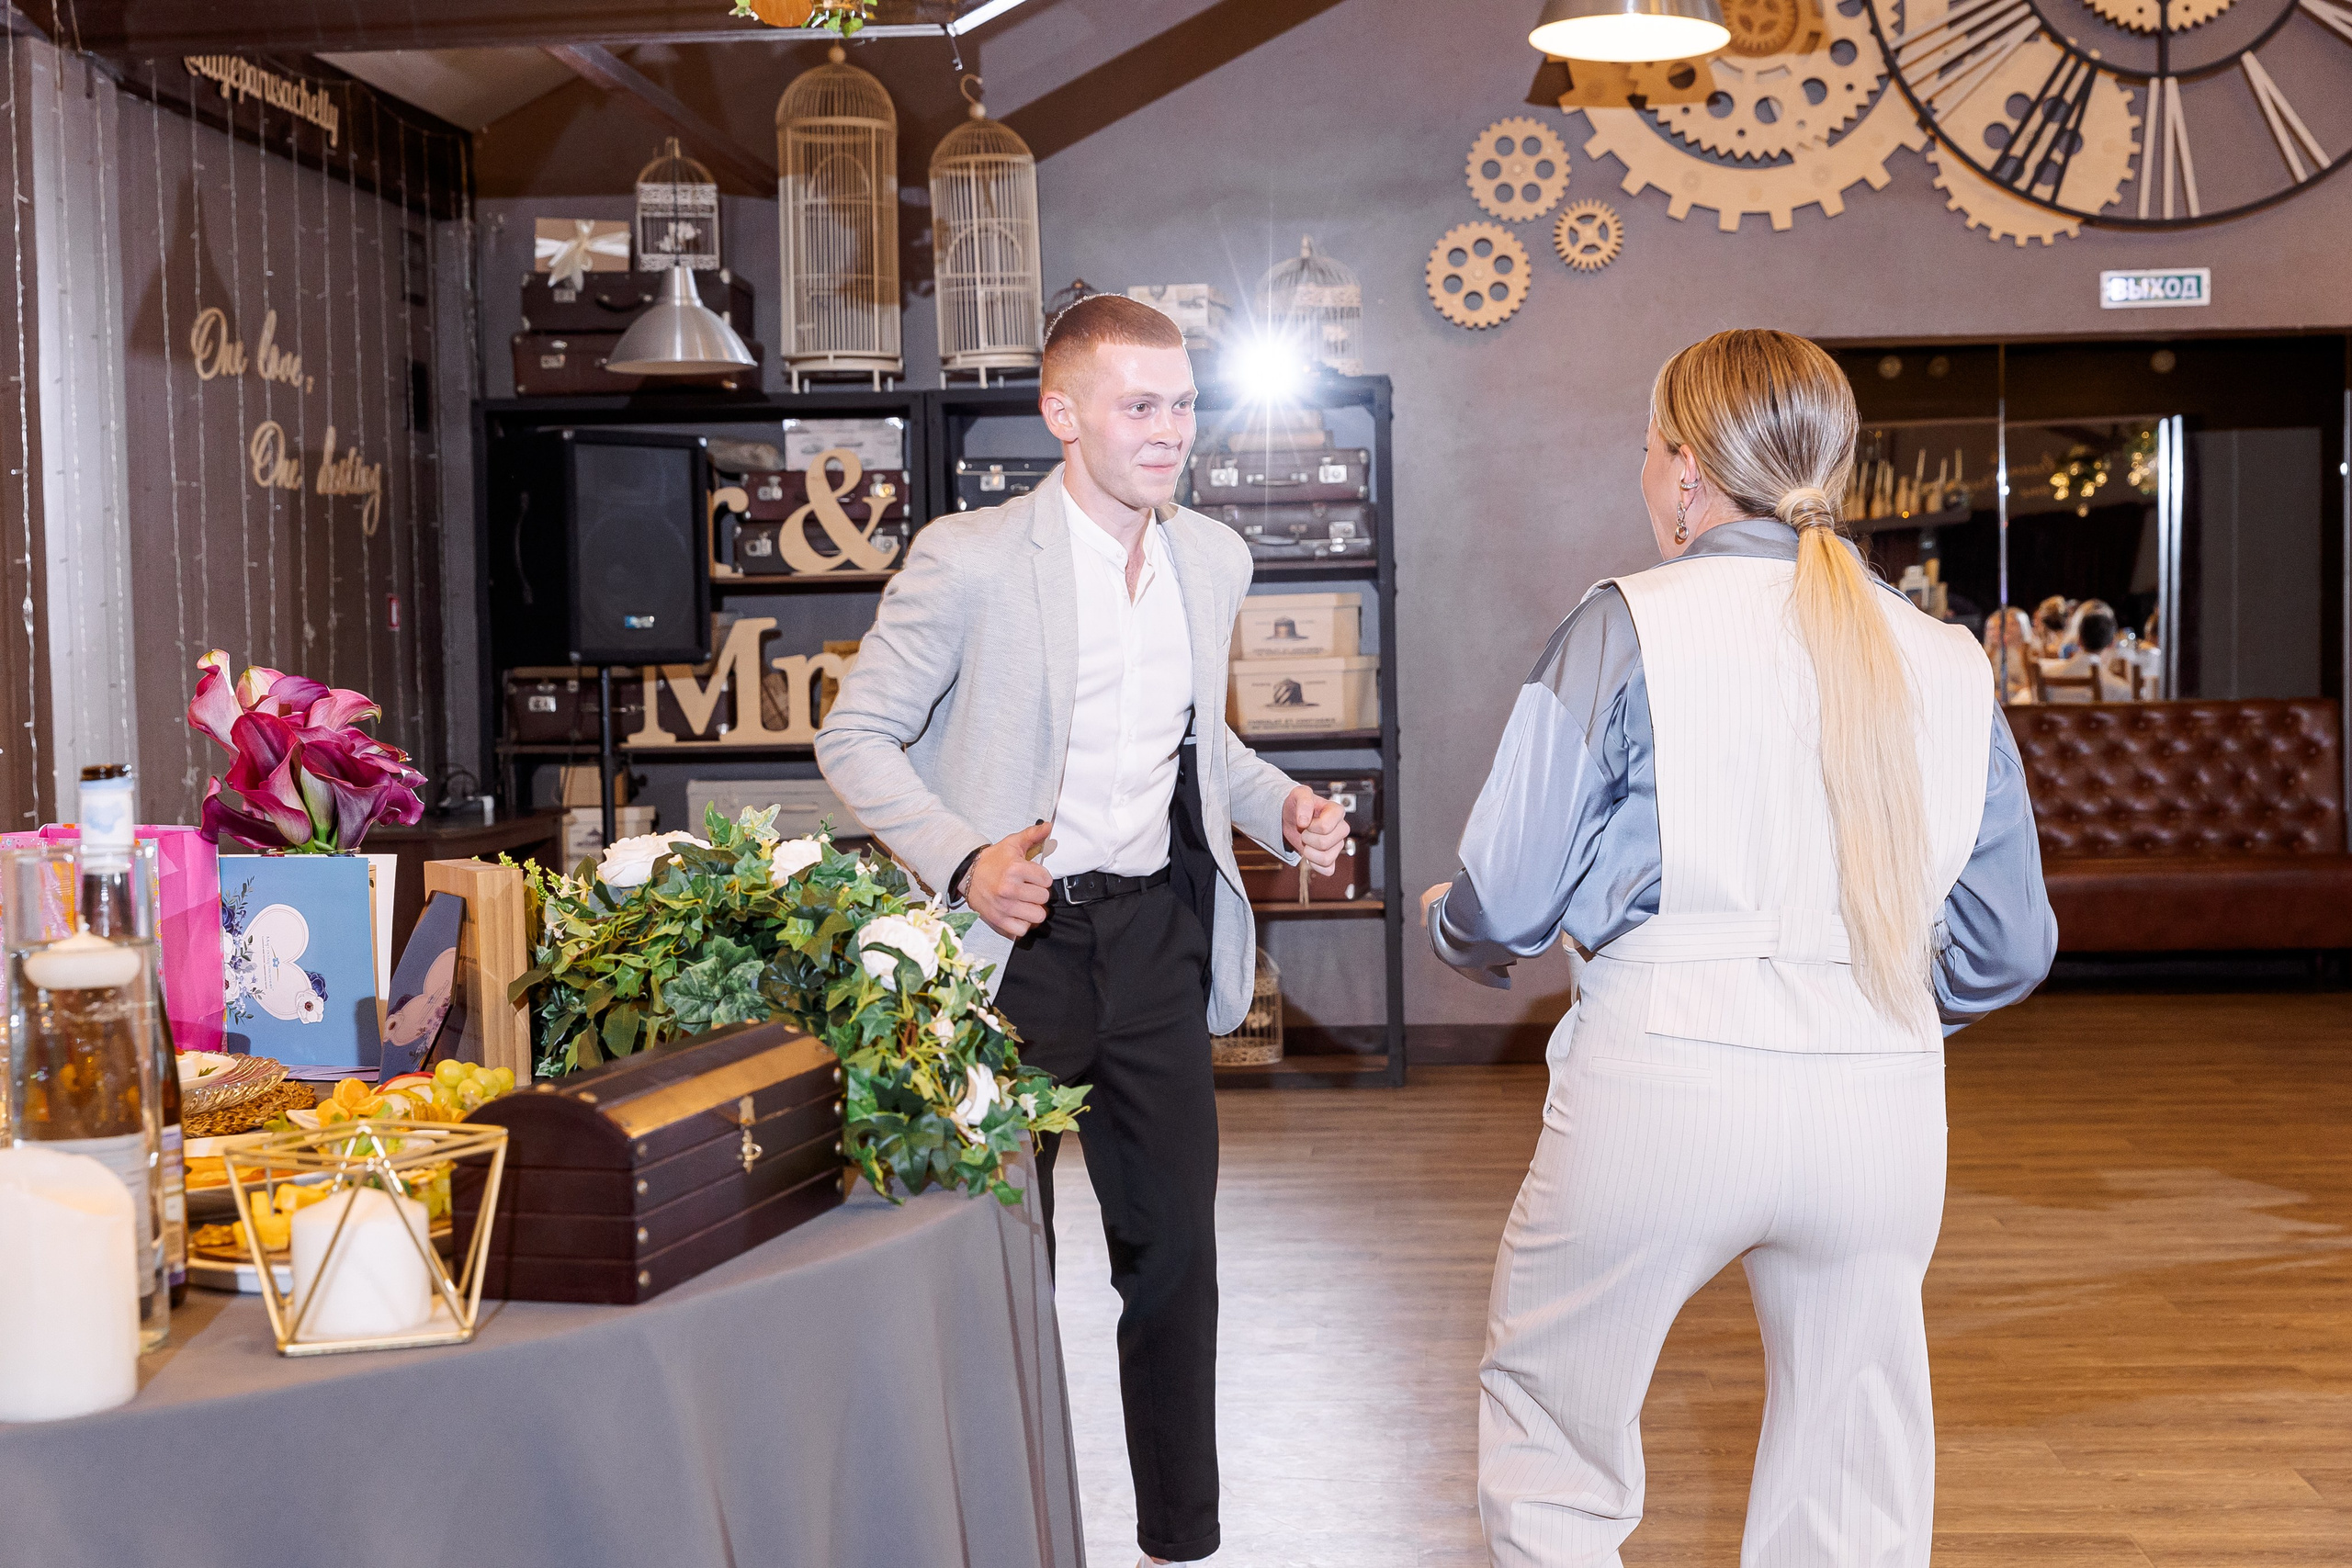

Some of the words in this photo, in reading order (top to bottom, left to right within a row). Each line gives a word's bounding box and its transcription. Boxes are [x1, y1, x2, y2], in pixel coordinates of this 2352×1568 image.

[2109, 276, 2199, 301] ВЫХОД
[191, 308, 248, 380] One
[250, 420, 303, 490] One
[778, 447, 900, 571] &
[628, 617, 859, 744] Mr
